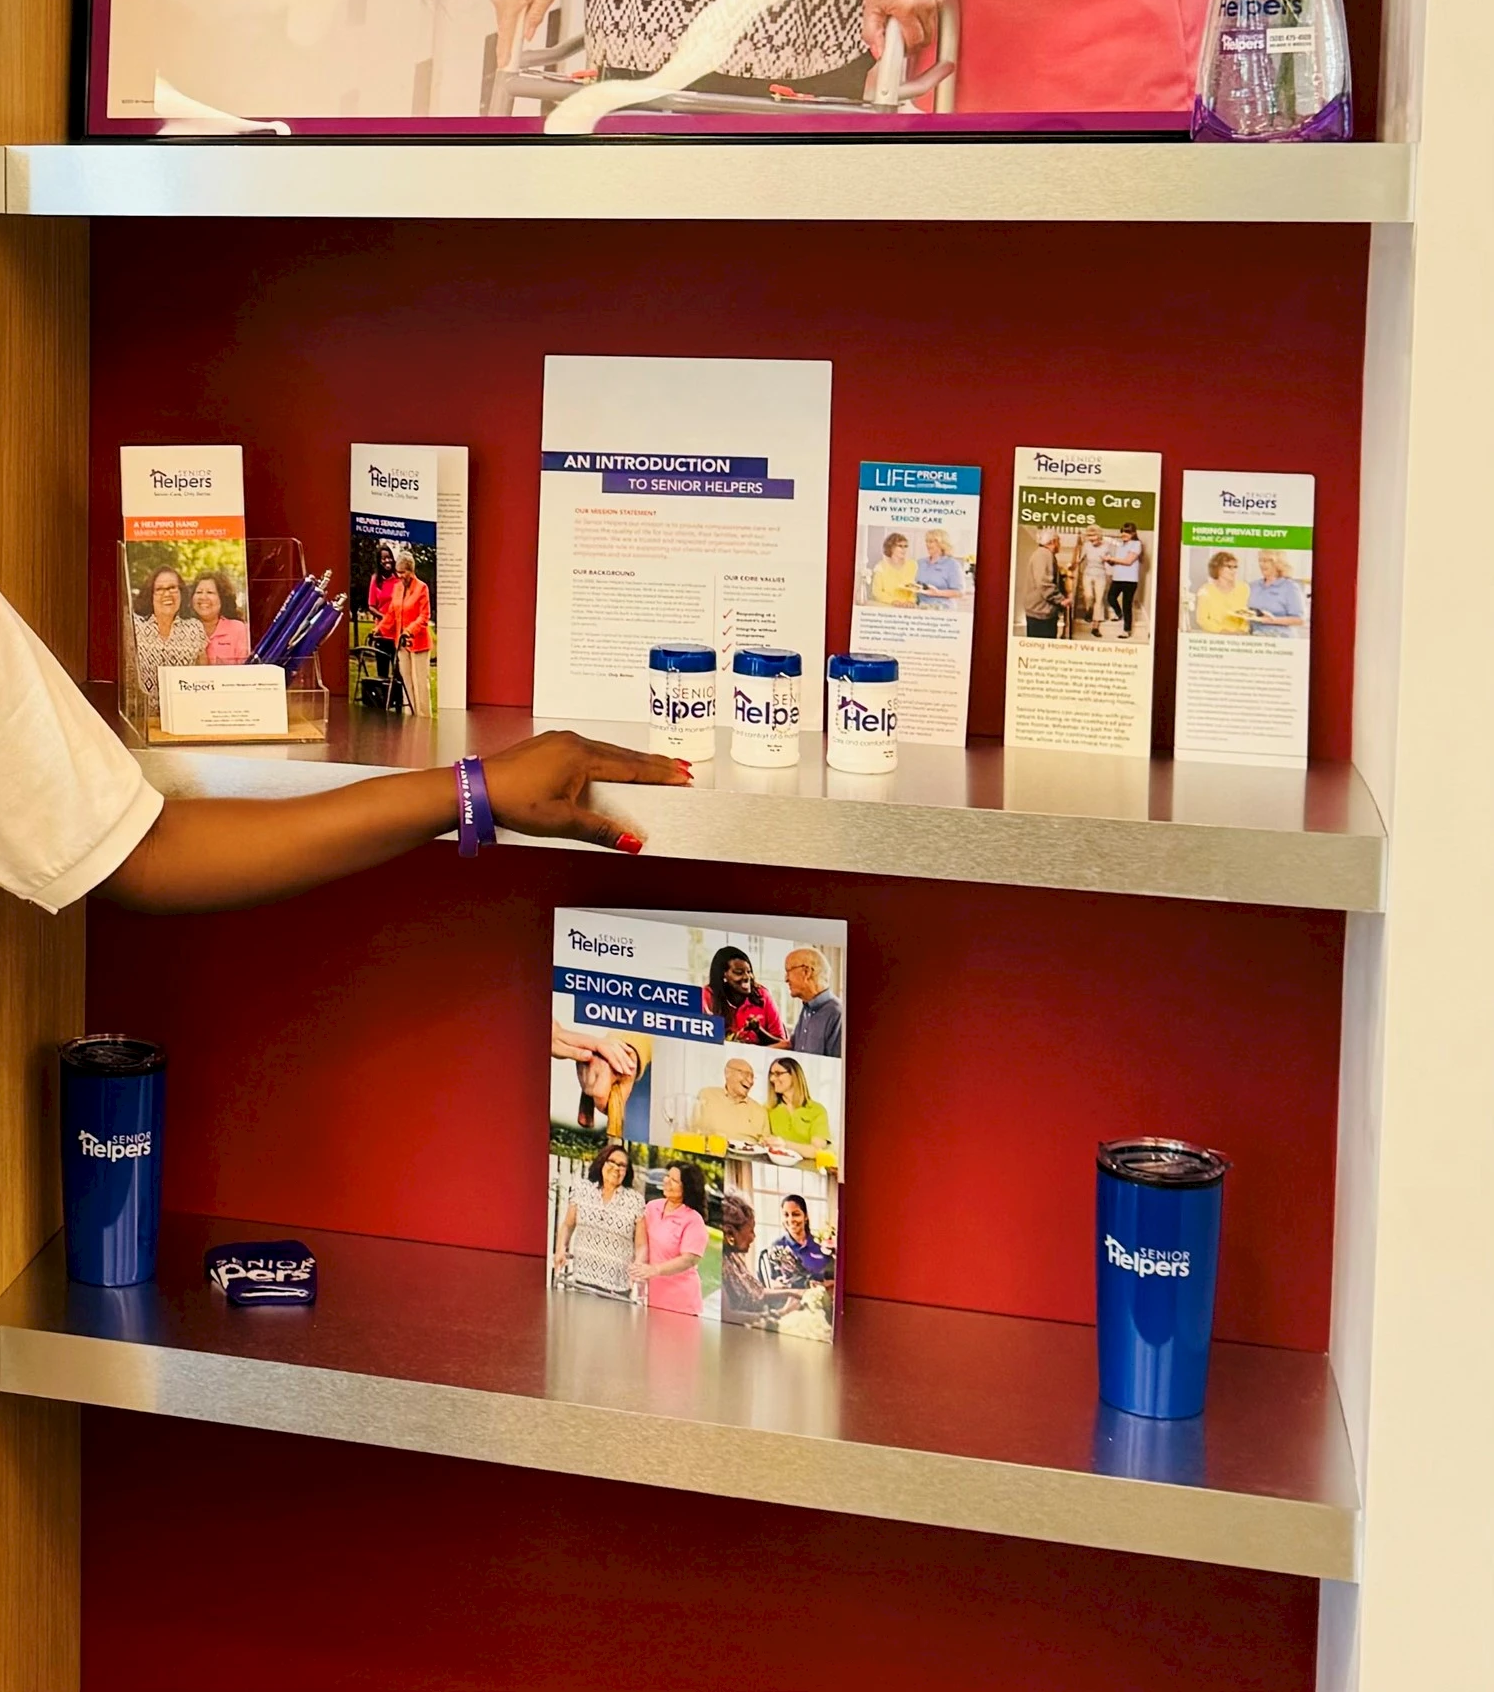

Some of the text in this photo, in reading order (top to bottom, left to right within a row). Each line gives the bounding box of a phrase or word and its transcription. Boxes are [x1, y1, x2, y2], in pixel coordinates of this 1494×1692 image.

[563, 455, 730, 474] AN INTRODUCTION
[1037, 459, 1102, 476] Helpers
[153, 475, 212, 491] Helpers
[371, 472, 419, 492] Helpers
[628, 478, 763, 494] TO SENIOR HELPERS
[875, 468, 917, 488] LIFE
[917, 470, 958, 481] PROFILE
[1022, 490, 1142, 508] In-Home Care
[1222, 496, 1277, 510] Helpers
[922, 516, 943, 524] CARE
[1021, 508, 1096, 524] Services
[1226, 528, 1261, 537] PRIVATE
[1263, 529, 1288, 538] DUTY
[572, 935, 634, 958] Helpers
[598, 933, 634, 945] SENIOR
[564, 973, 689, 1006] SENIOR CARE
[585, 1003, 714, 1037] ONLY BETTER
[112, 1131, 152, 1144] SENIOR
[82, 1139, 151, 1162] Helpers
[1108, 1244, 1190, 1278] Helpers
[1139, 1246, 1190, 1261] SENIOR
